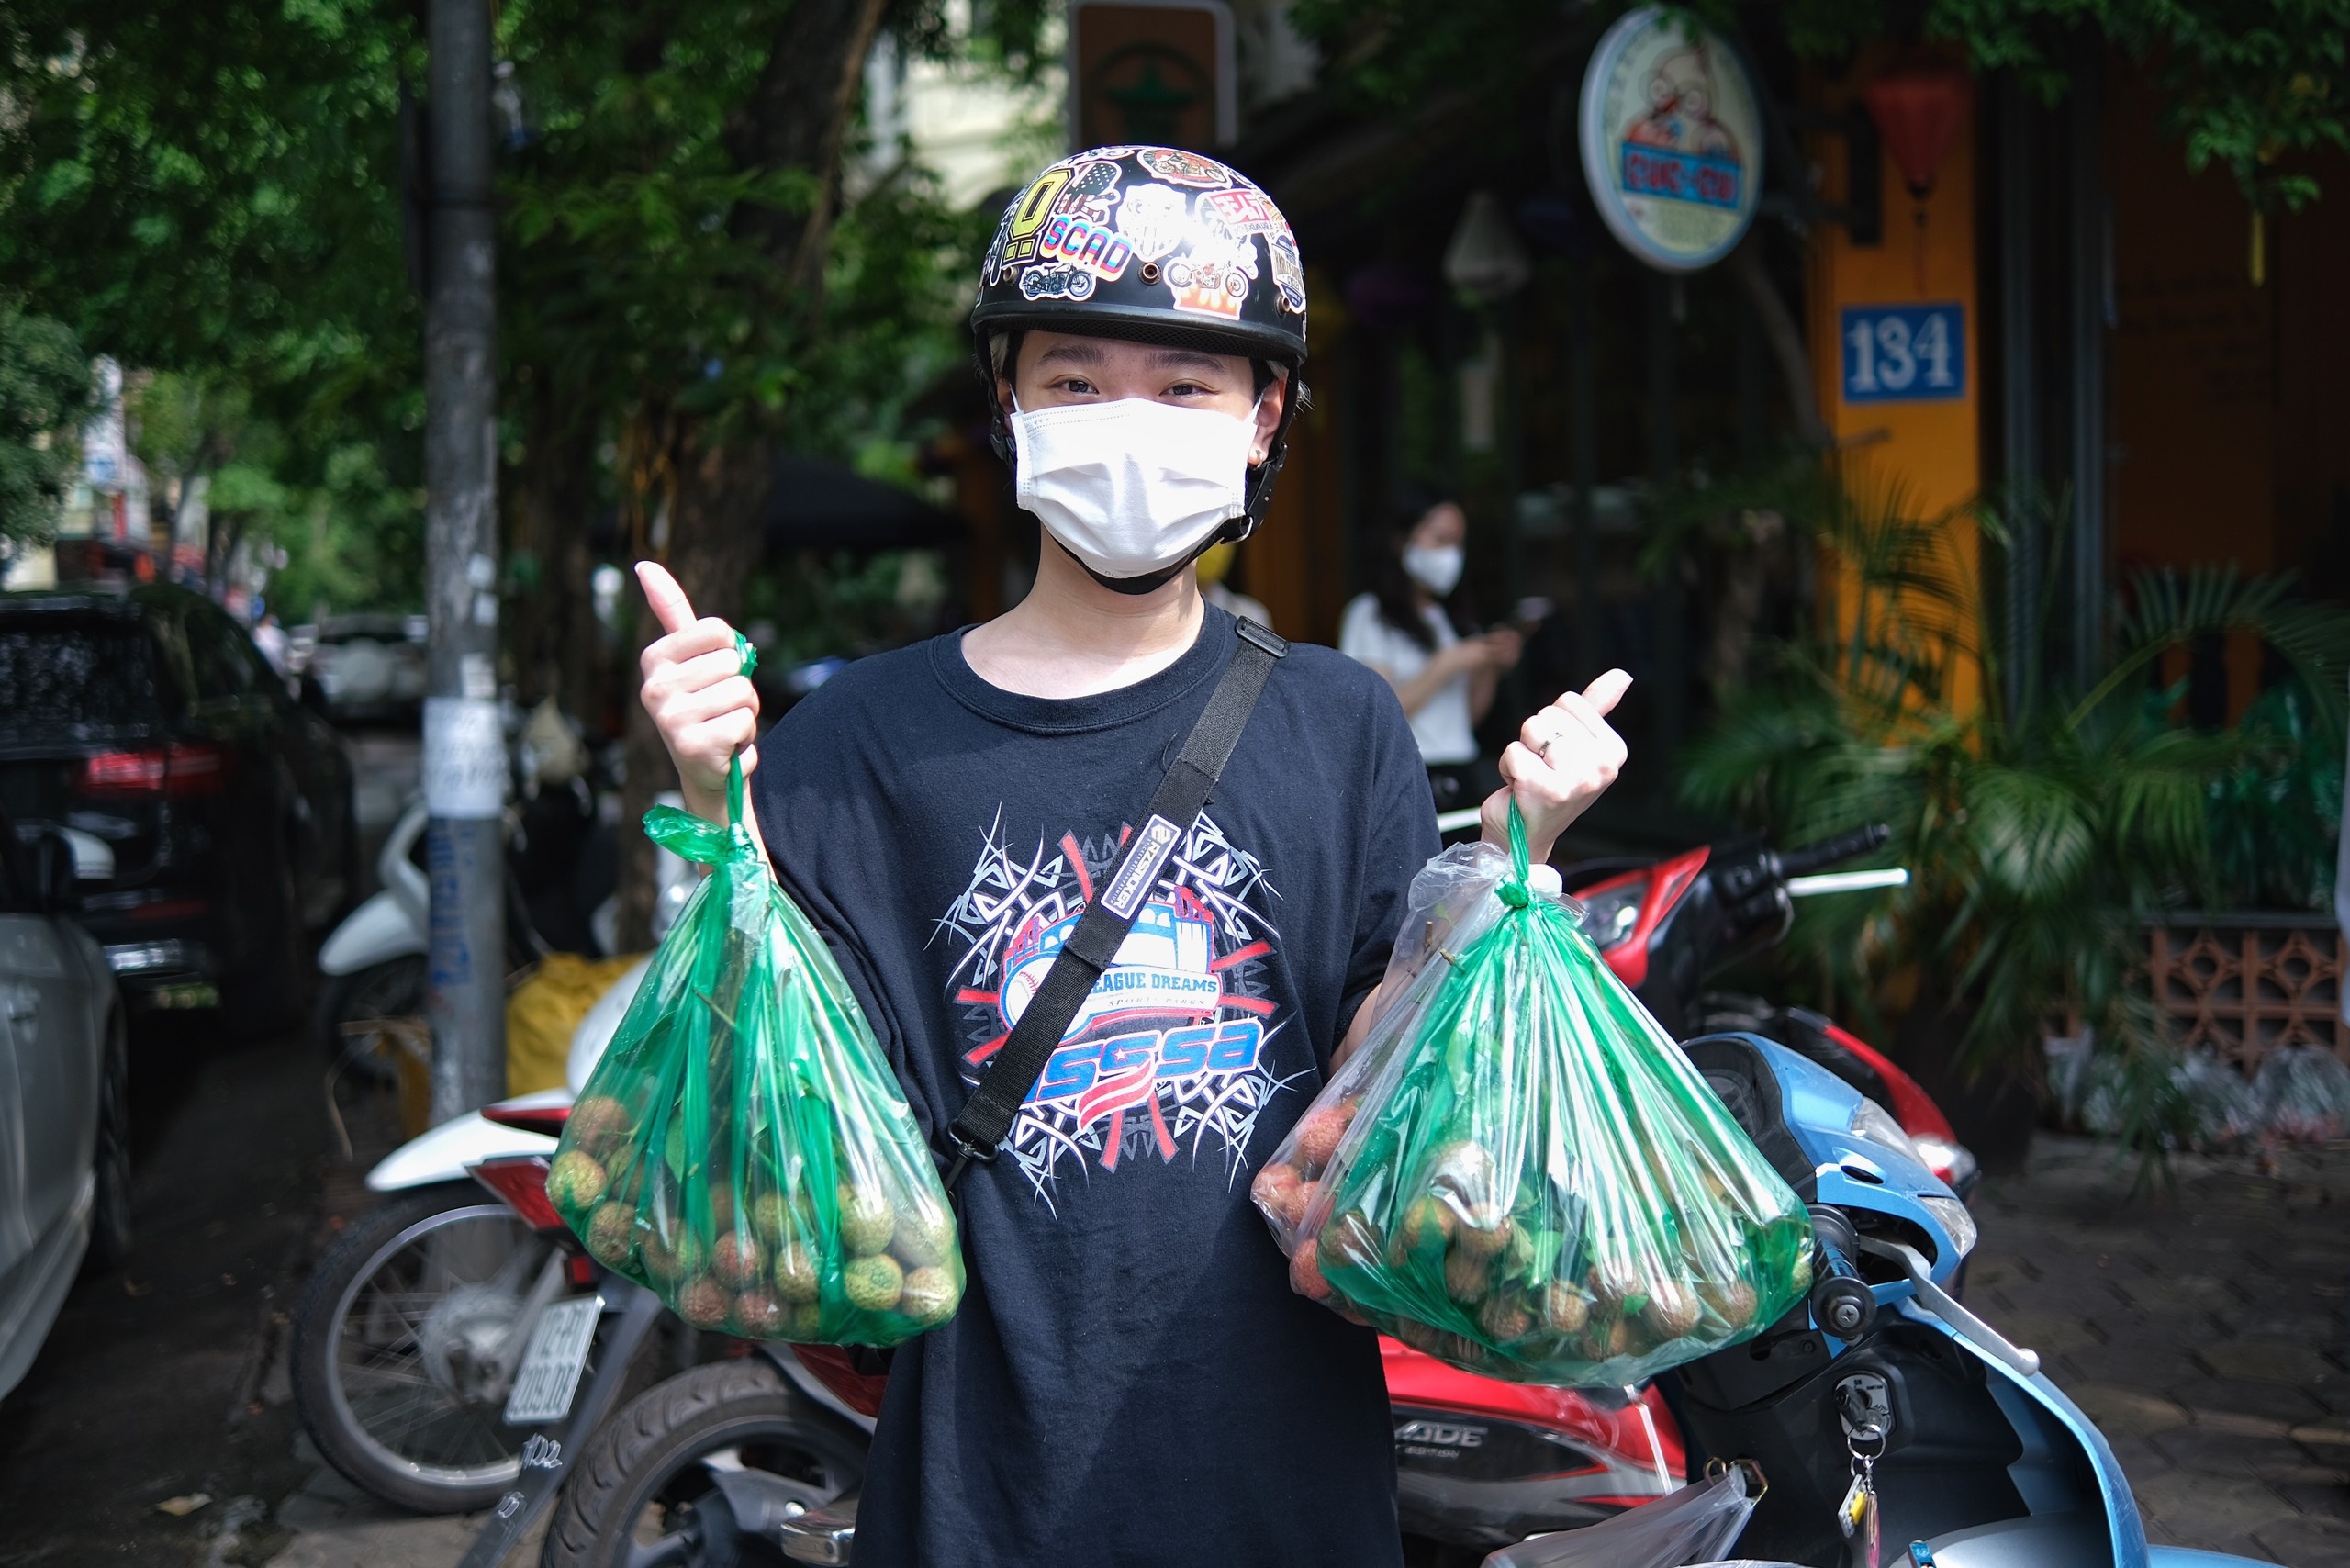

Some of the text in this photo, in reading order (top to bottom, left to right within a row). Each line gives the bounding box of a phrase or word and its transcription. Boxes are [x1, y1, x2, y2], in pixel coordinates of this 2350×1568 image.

[1043, 215, 1134, 277] SCAD
[1844, 313, 1954, 393] 134
[1091, 972, 1217, 994] EAGUE DREAMS
